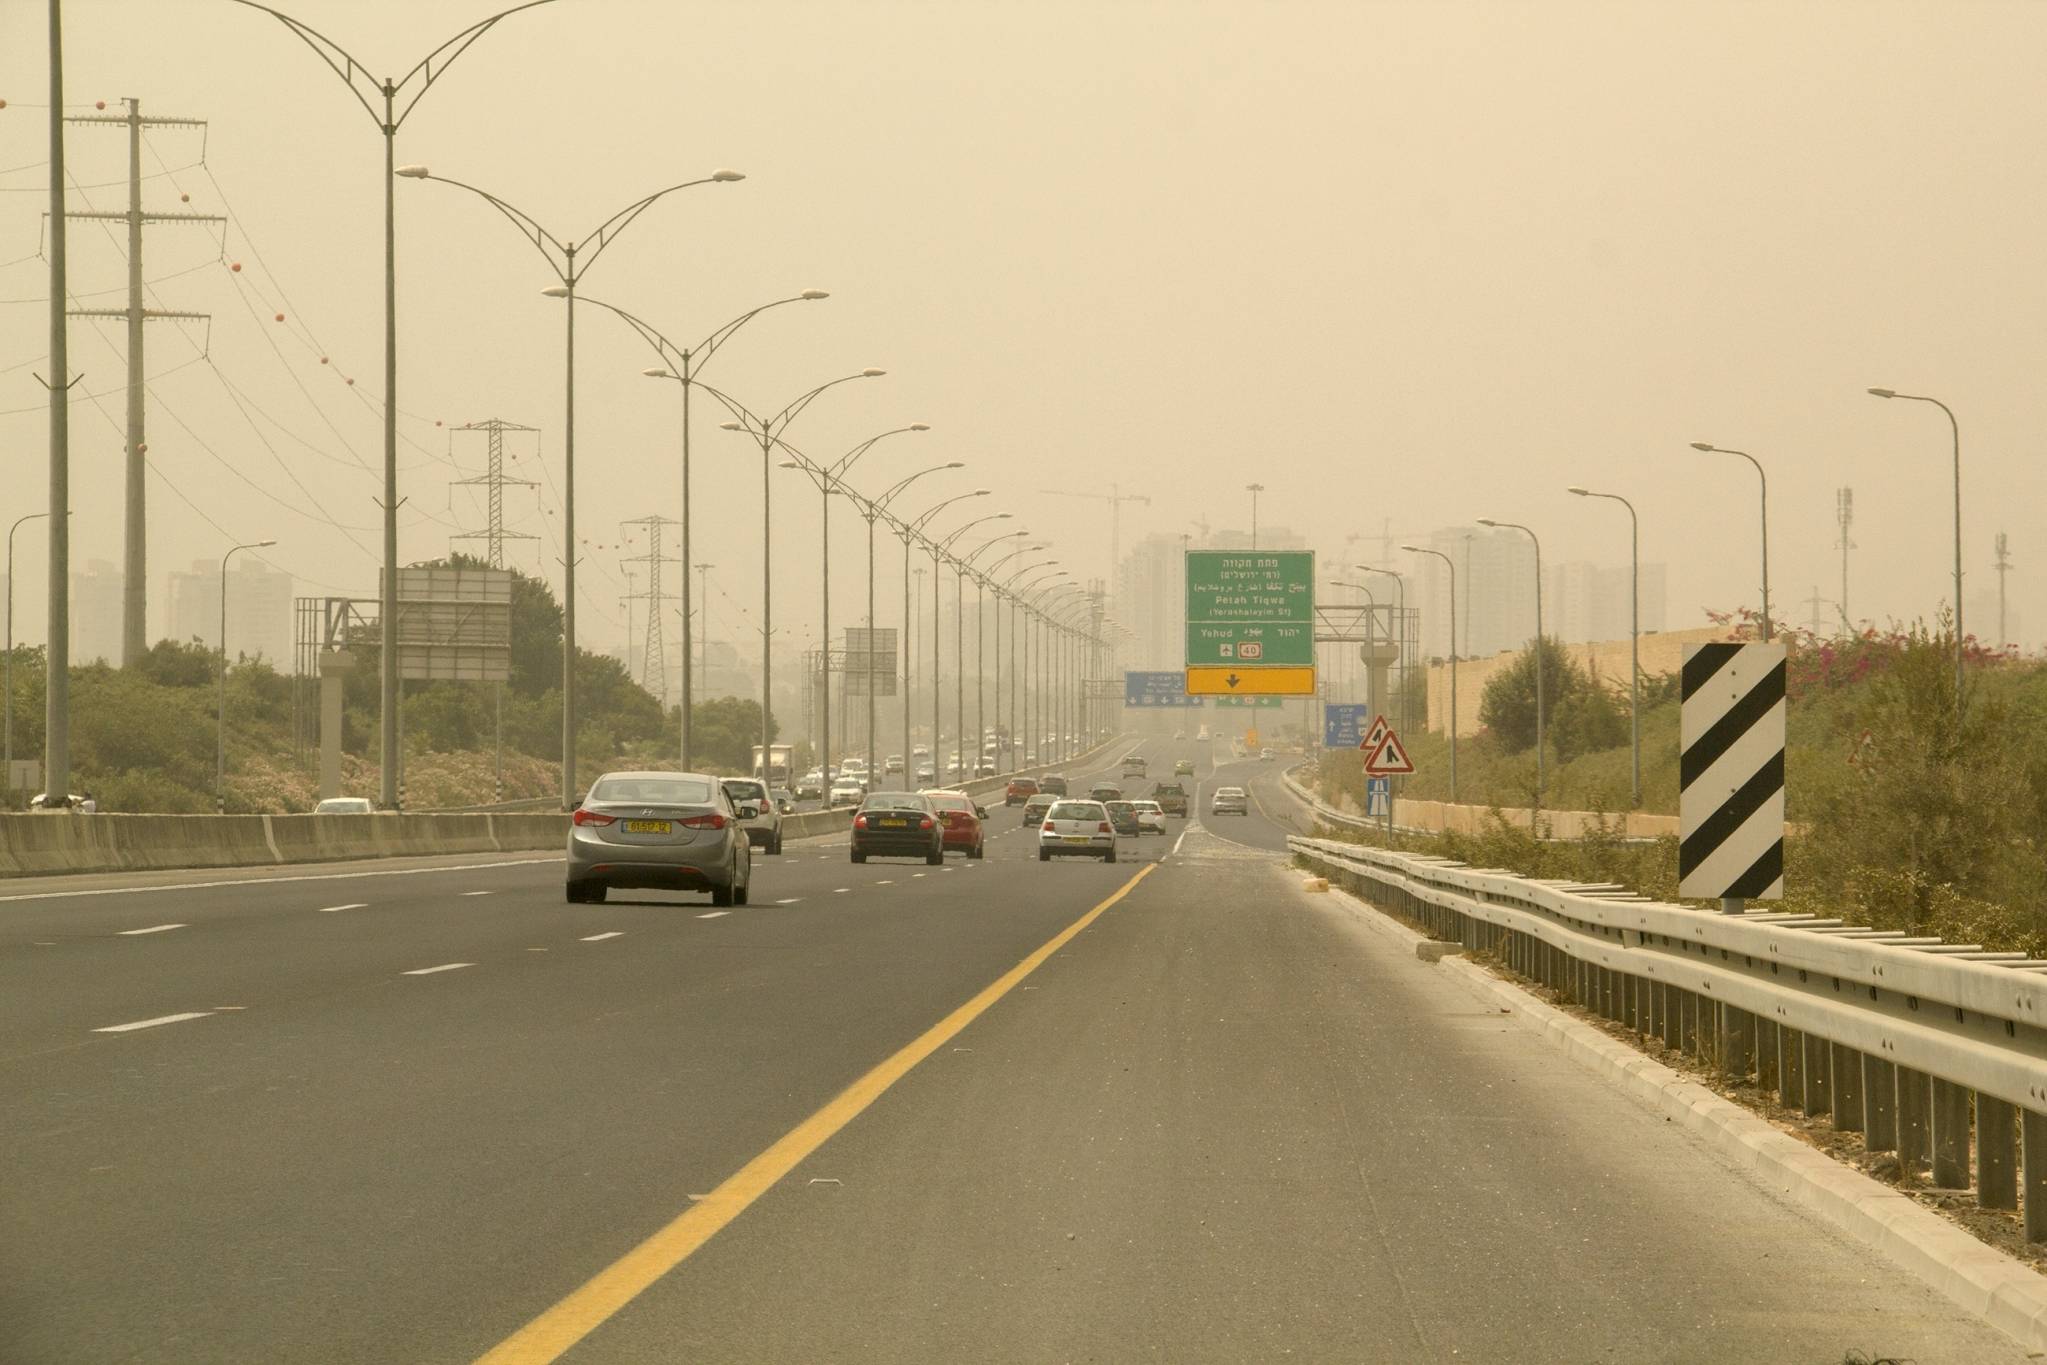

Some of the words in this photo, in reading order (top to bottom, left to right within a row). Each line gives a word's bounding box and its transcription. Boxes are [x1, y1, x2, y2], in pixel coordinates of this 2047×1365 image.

[1215, 595, 1247, 605] Petah
[1252, 595, 1286, 606] Tiqwa
[1200, 628, 1233, 638] Yehud
[1242, 646, 1257, 655] 40
